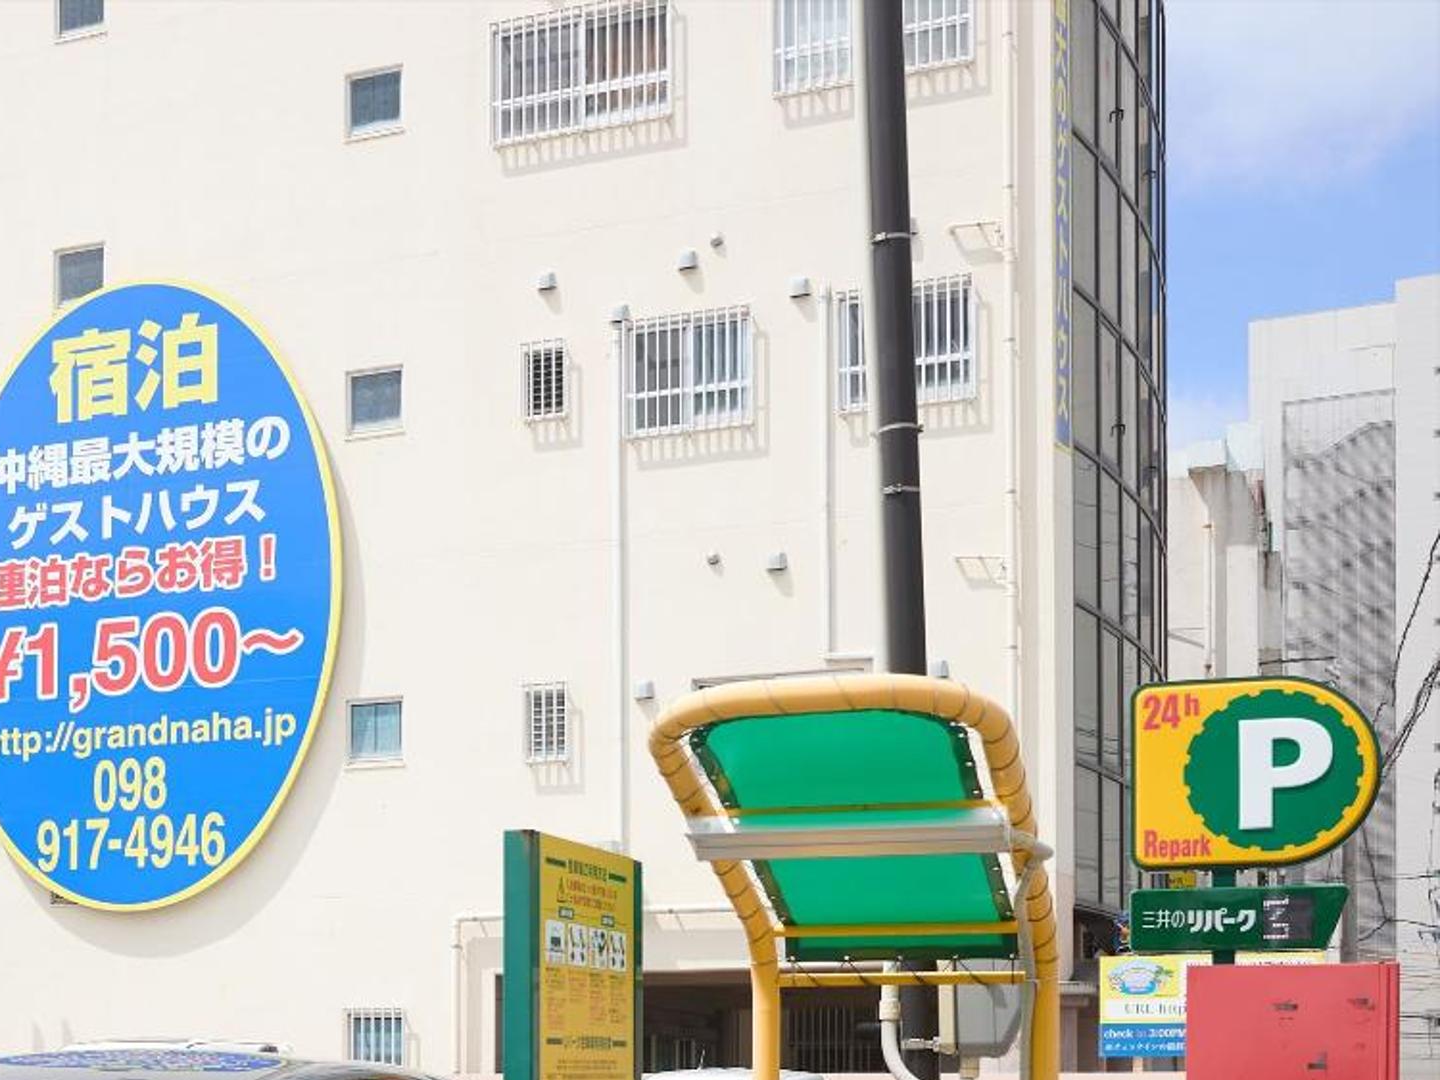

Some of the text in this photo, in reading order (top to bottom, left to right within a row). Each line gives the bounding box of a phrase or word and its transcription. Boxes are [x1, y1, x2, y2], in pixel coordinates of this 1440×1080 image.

[49, 312, 219, 424] 宿泊
[7, 480, 267, 550] ゲストハウス
[92, 757, 168, 812] 098
[1237, 717, 1335, 830] P
[35, 811, 227, 875] 917-4946
[1143, 830, 1211, 860] Repark
[1141, 908, 1257, 934] 三井のリパーク
